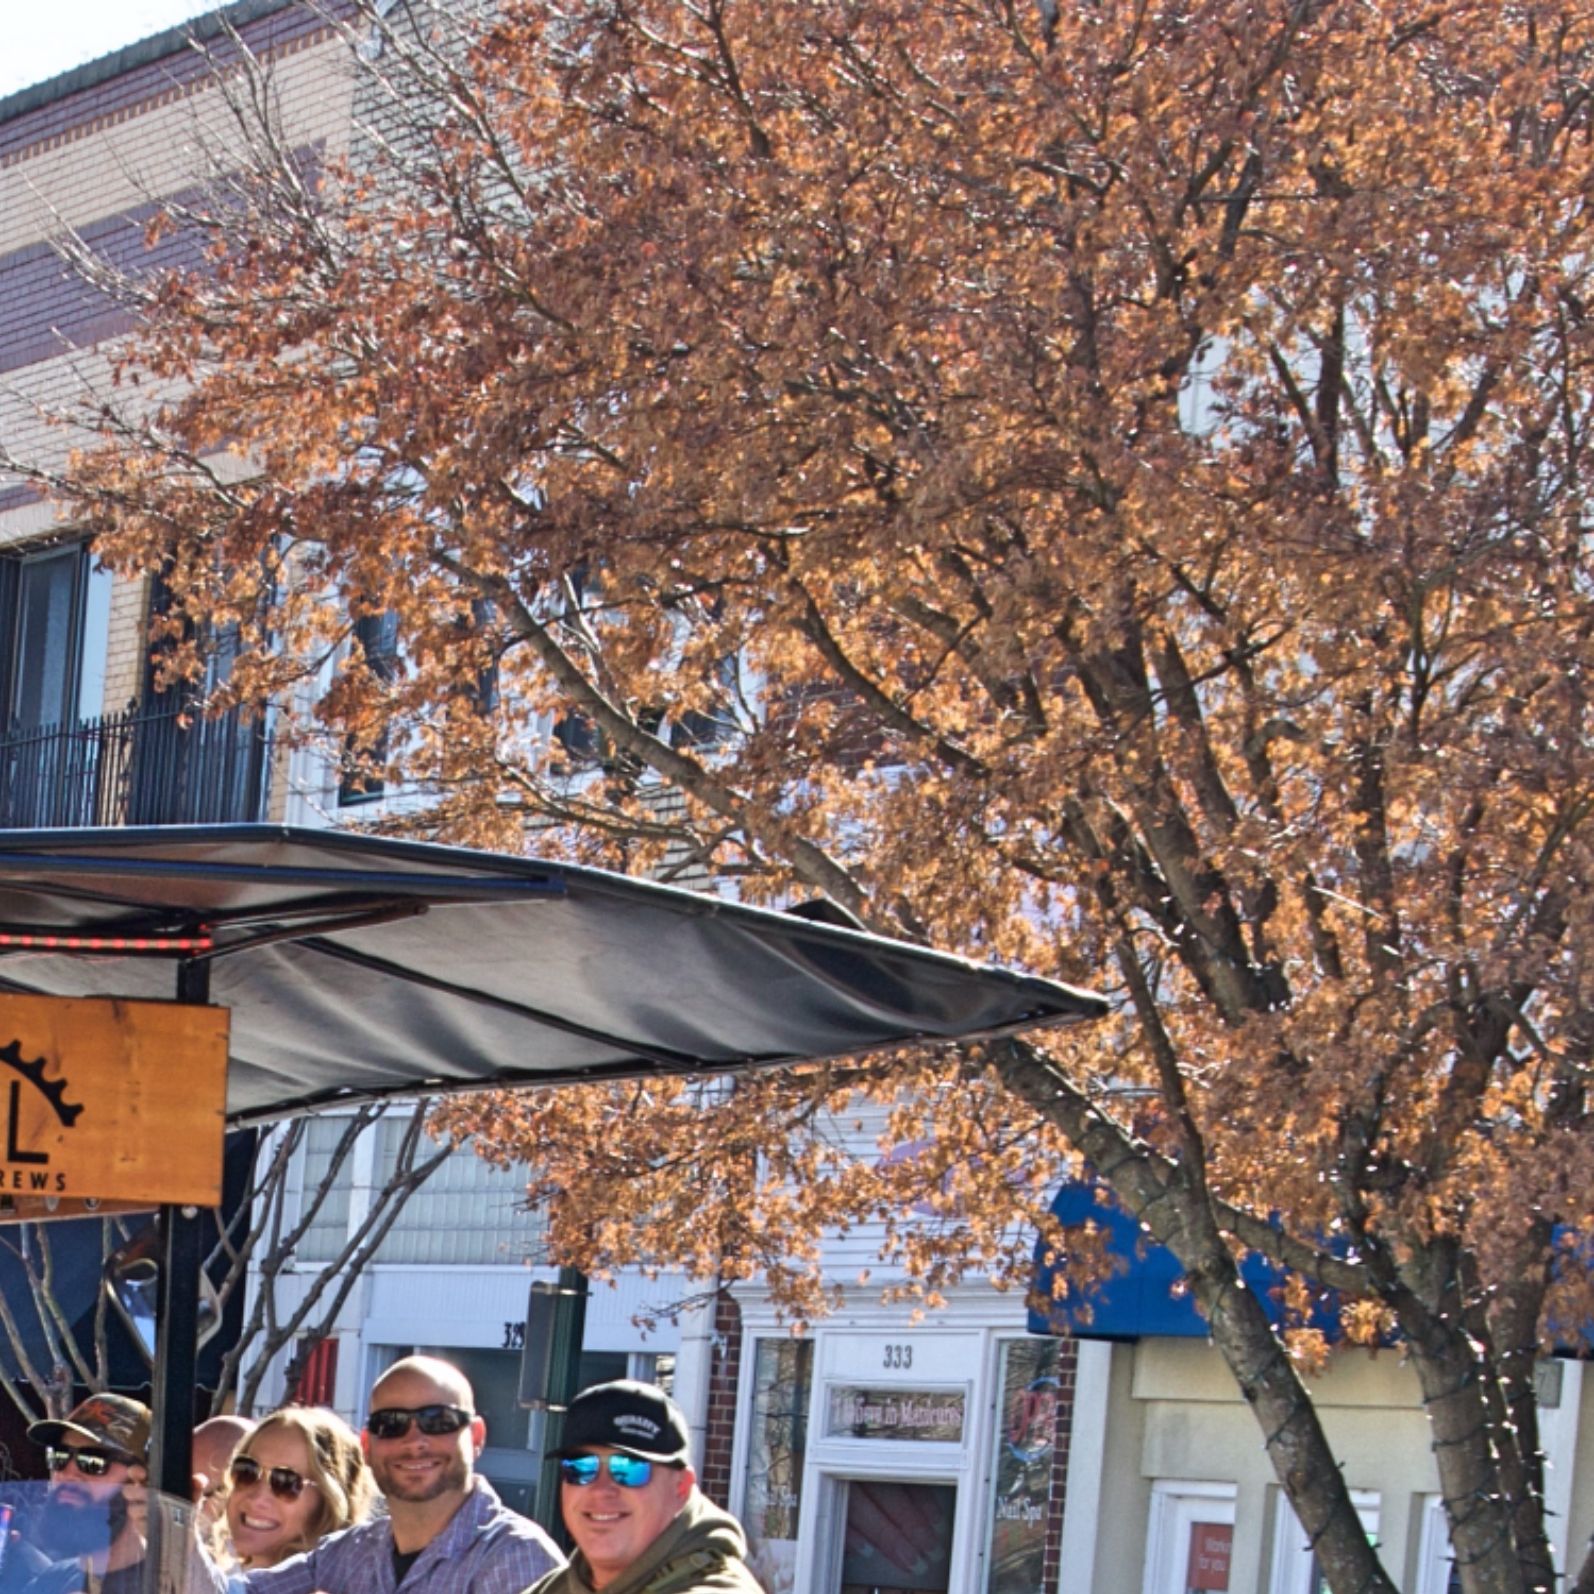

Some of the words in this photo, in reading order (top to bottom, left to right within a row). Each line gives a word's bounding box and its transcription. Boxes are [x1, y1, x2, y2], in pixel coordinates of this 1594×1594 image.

[883, 1344, 914, 1369] 333
[996, 1496, 1020, 1519] Nail
[1022, 1496, 1043, 1529] Spa
